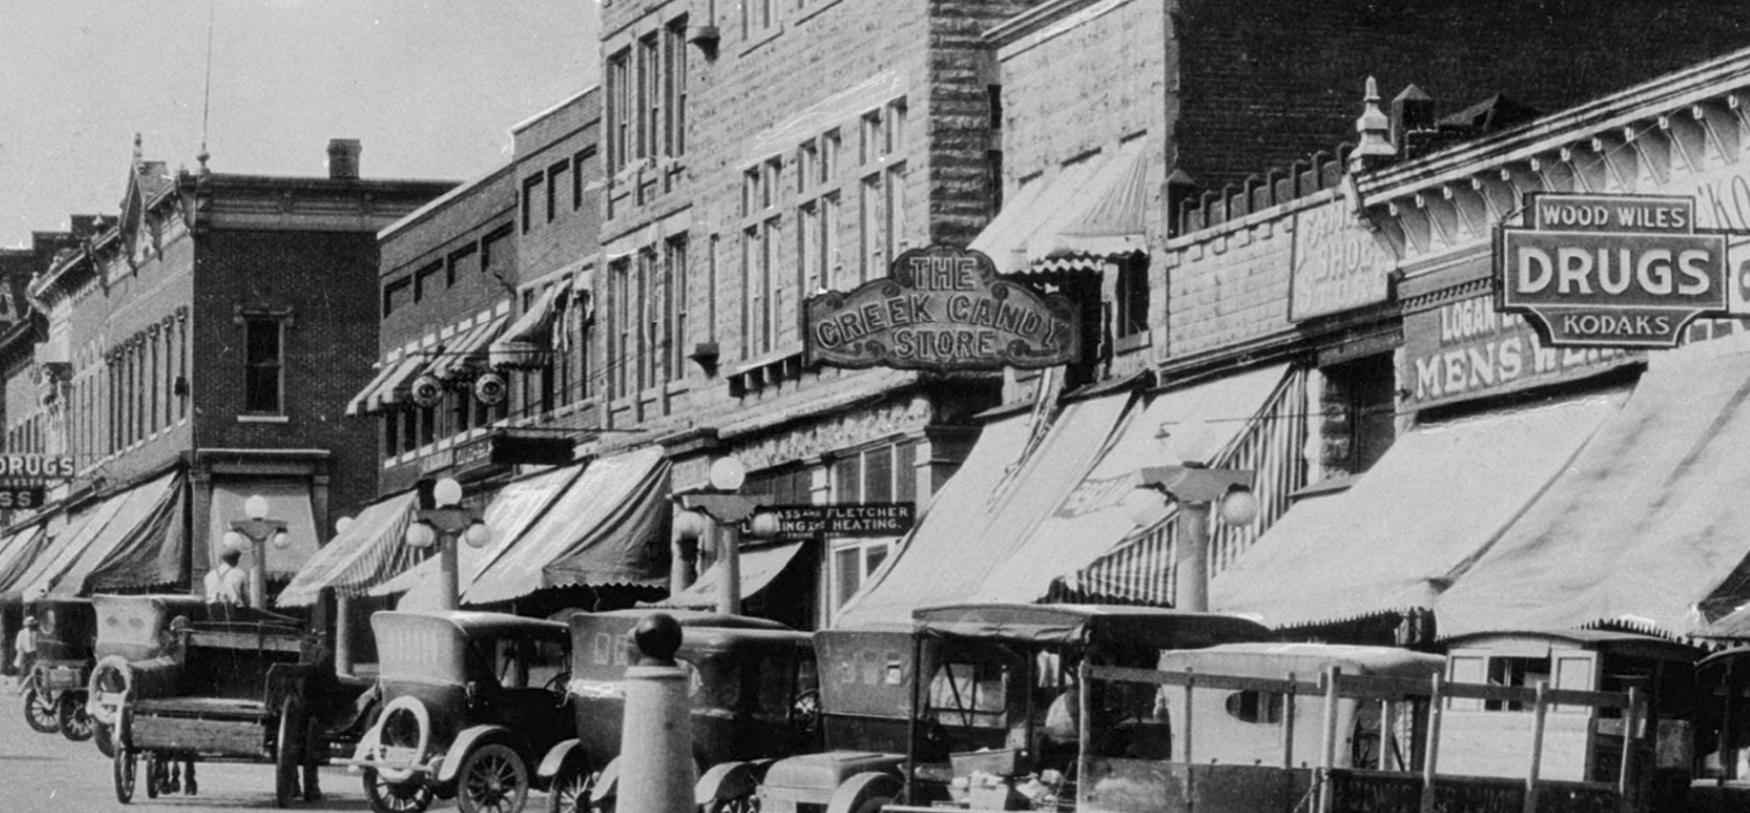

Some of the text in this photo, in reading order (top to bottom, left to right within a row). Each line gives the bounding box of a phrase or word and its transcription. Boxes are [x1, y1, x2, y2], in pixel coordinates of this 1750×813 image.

[1543, 205, 1686, 229] WOOD WILES
[910, 256, 977, 291] THE
[1517, 247, 1711, 295] DRUGS
[947, 293, 1070, 348] CANDY
[1441, 292, 1496, 343] LOGAN
[1564, 315, 1671, 335] KODAKS
[893, 328, 998, 358] STORE
[1415, 337, 1523, 399] MENS
[826, 507, 908, 518] FLETCHER
